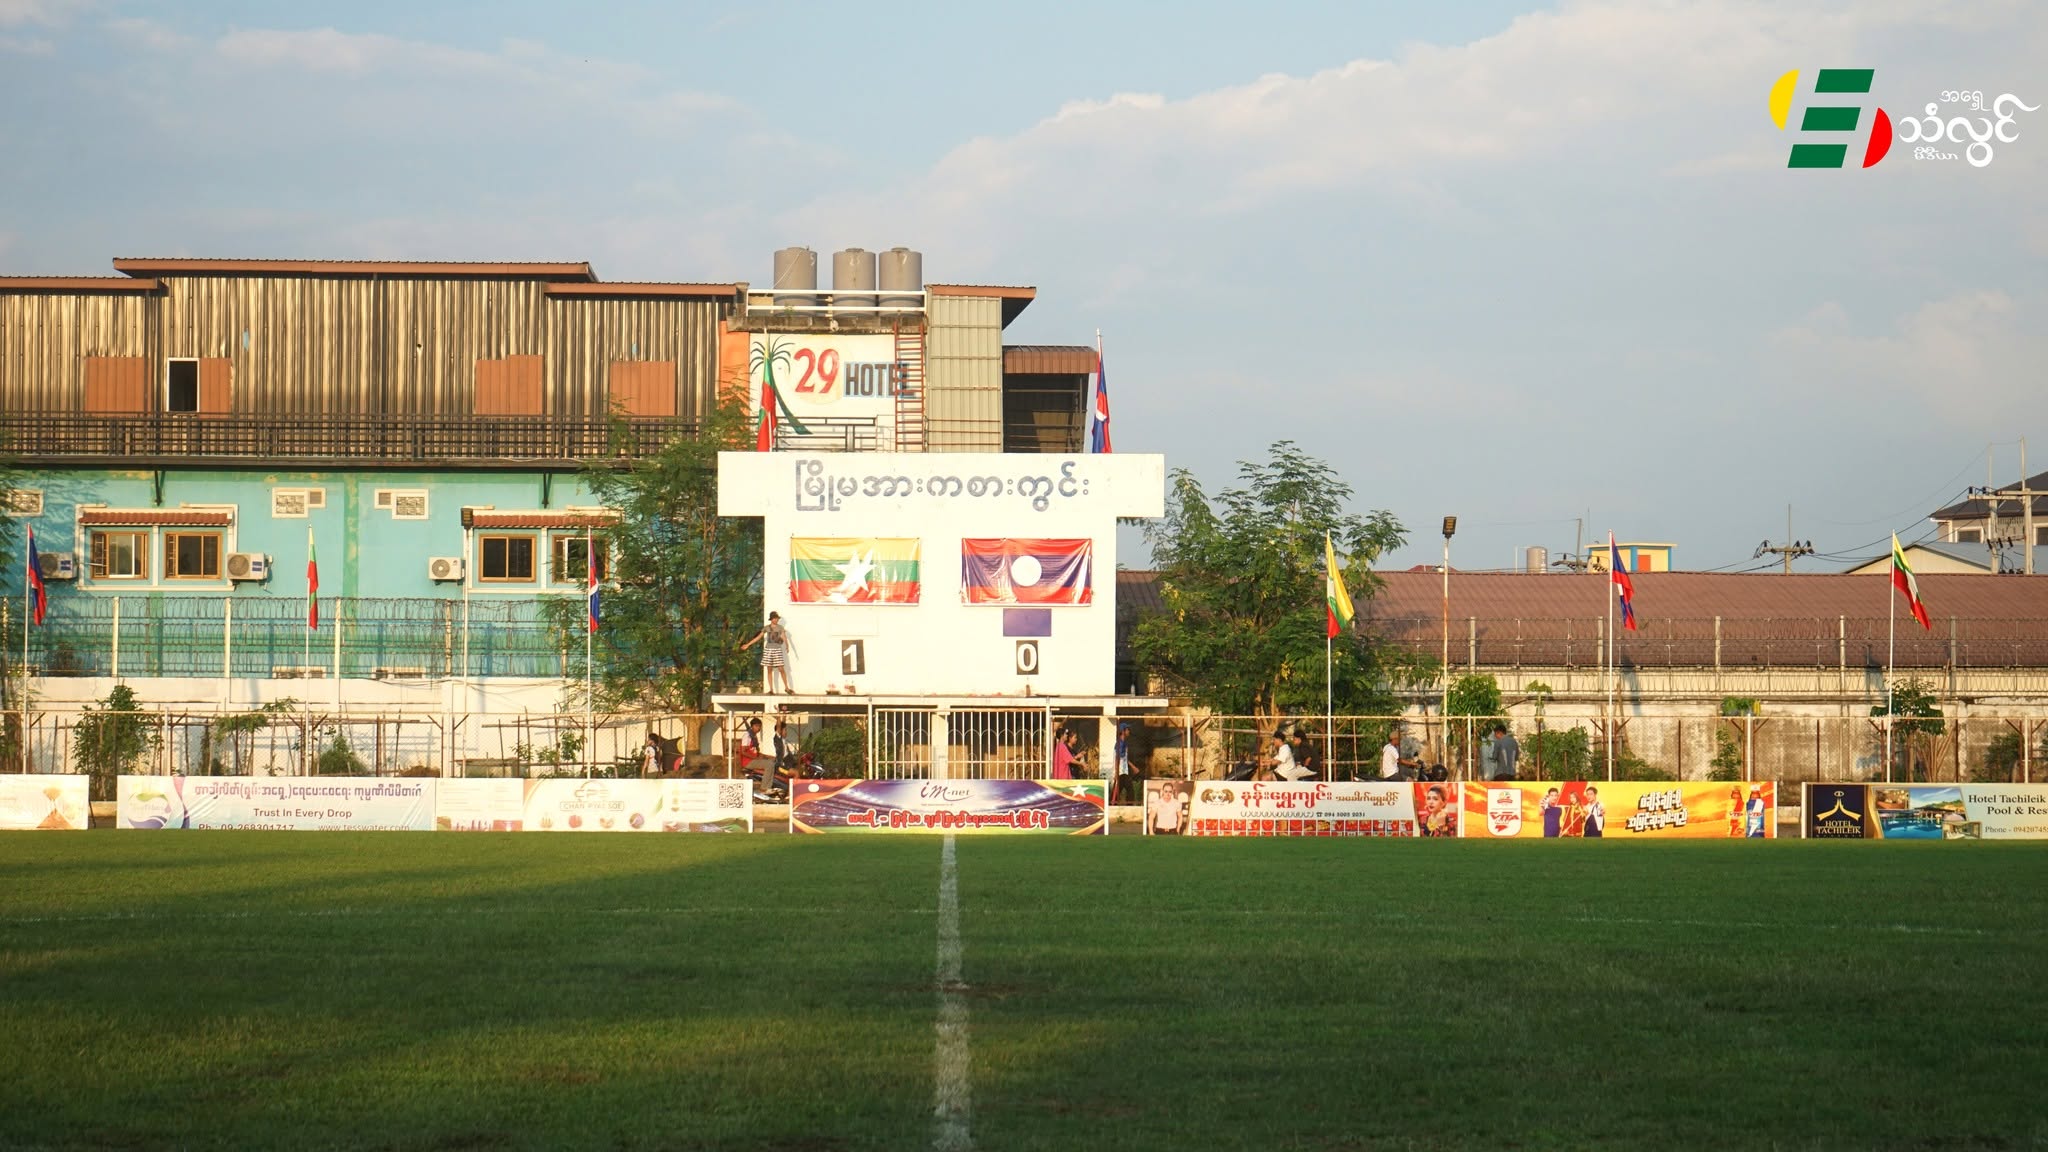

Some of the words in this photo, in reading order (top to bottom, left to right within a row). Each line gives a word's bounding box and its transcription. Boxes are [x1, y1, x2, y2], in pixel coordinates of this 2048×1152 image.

[793, 347, 840, 393] 29
[845, 362, 915, 397] HOTEL
[795, 459, 1089, 512] မြို့မအားကစားကွင်း
[843, 645, 858, 672] 1
[1017, 644, 1037, 671] 0
[1968, 794, 1996, 803] Hotel
[1999, 794, 2046, 803] Tachileik
[253, 808, 280, 817] Trust
[282, 808, 292, 817] In
[295, 808, 324, 819] Every
[327, 808, 352, 819] Drop
[1987, 806, 2011, 815] Pool
[2014, 806, 2024, 815] &
[2028, 806, 2048, 815] Res
[1816, 826, 1861, 834] TACHILEIK
[1985, 825, 2006, 833] Phone
